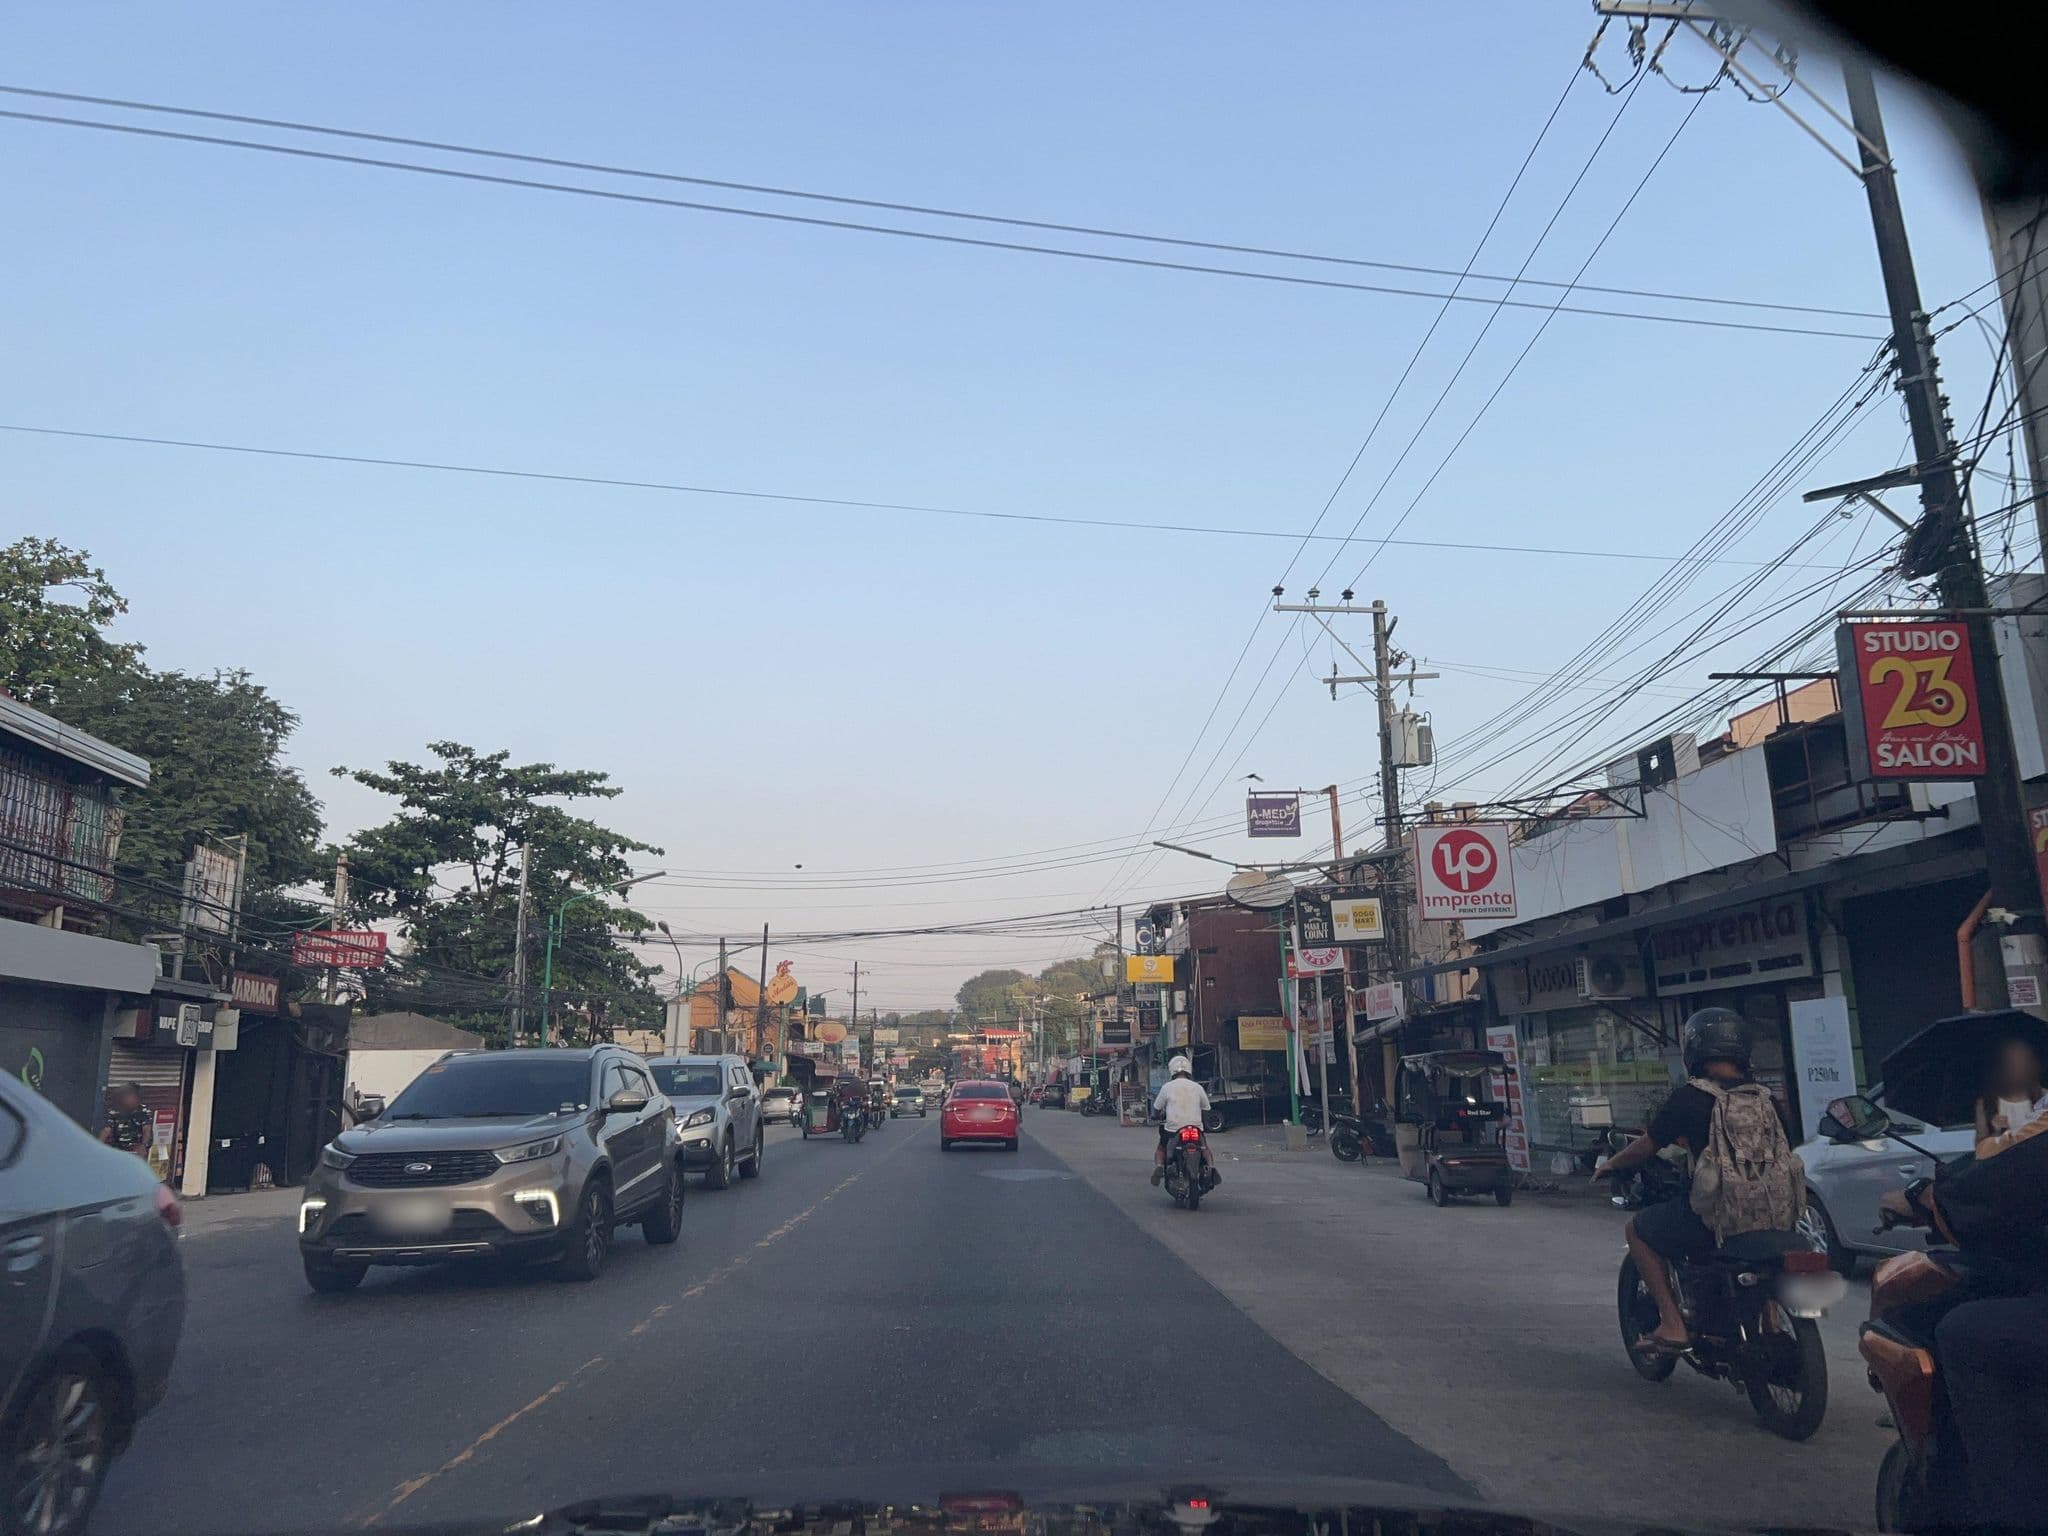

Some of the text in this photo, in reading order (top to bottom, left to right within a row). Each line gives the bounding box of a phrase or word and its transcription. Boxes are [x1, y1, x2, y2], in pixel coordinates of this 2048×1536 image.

[1864, 630, 1960, 652] STUDIO
[1869, 656, 1967, 729] 23
[1877, 742, 1978, 768] SALON
[1251, 809, 1287, 820] A-MED
[231, 977, 278, 1006] HARMACY
